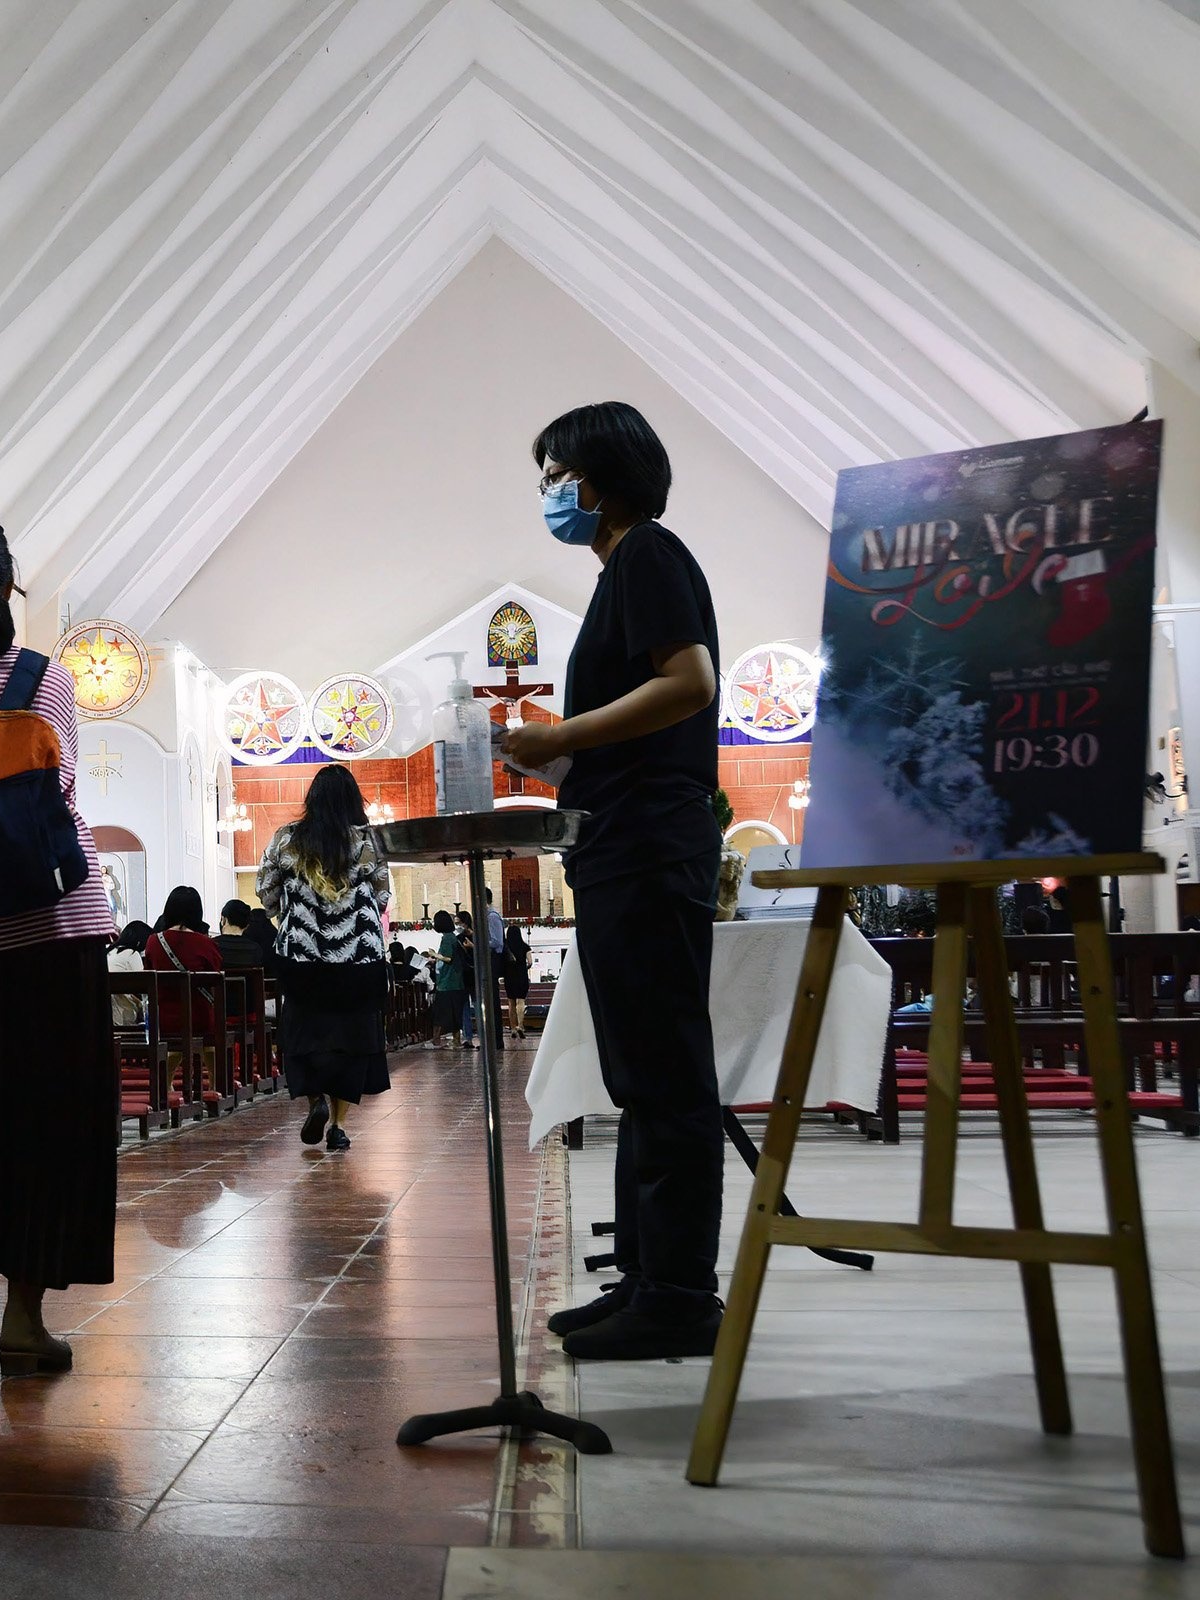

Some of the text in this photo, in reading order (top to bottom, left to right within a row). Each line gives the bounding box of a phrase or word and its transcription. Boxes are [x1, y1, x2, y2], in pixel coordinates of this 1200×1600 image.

[861, 497, 1113, 574] MIRACLE
[995, 686, 1101, 733] 21.12
[993, 731, 1101, 774] 19:30
